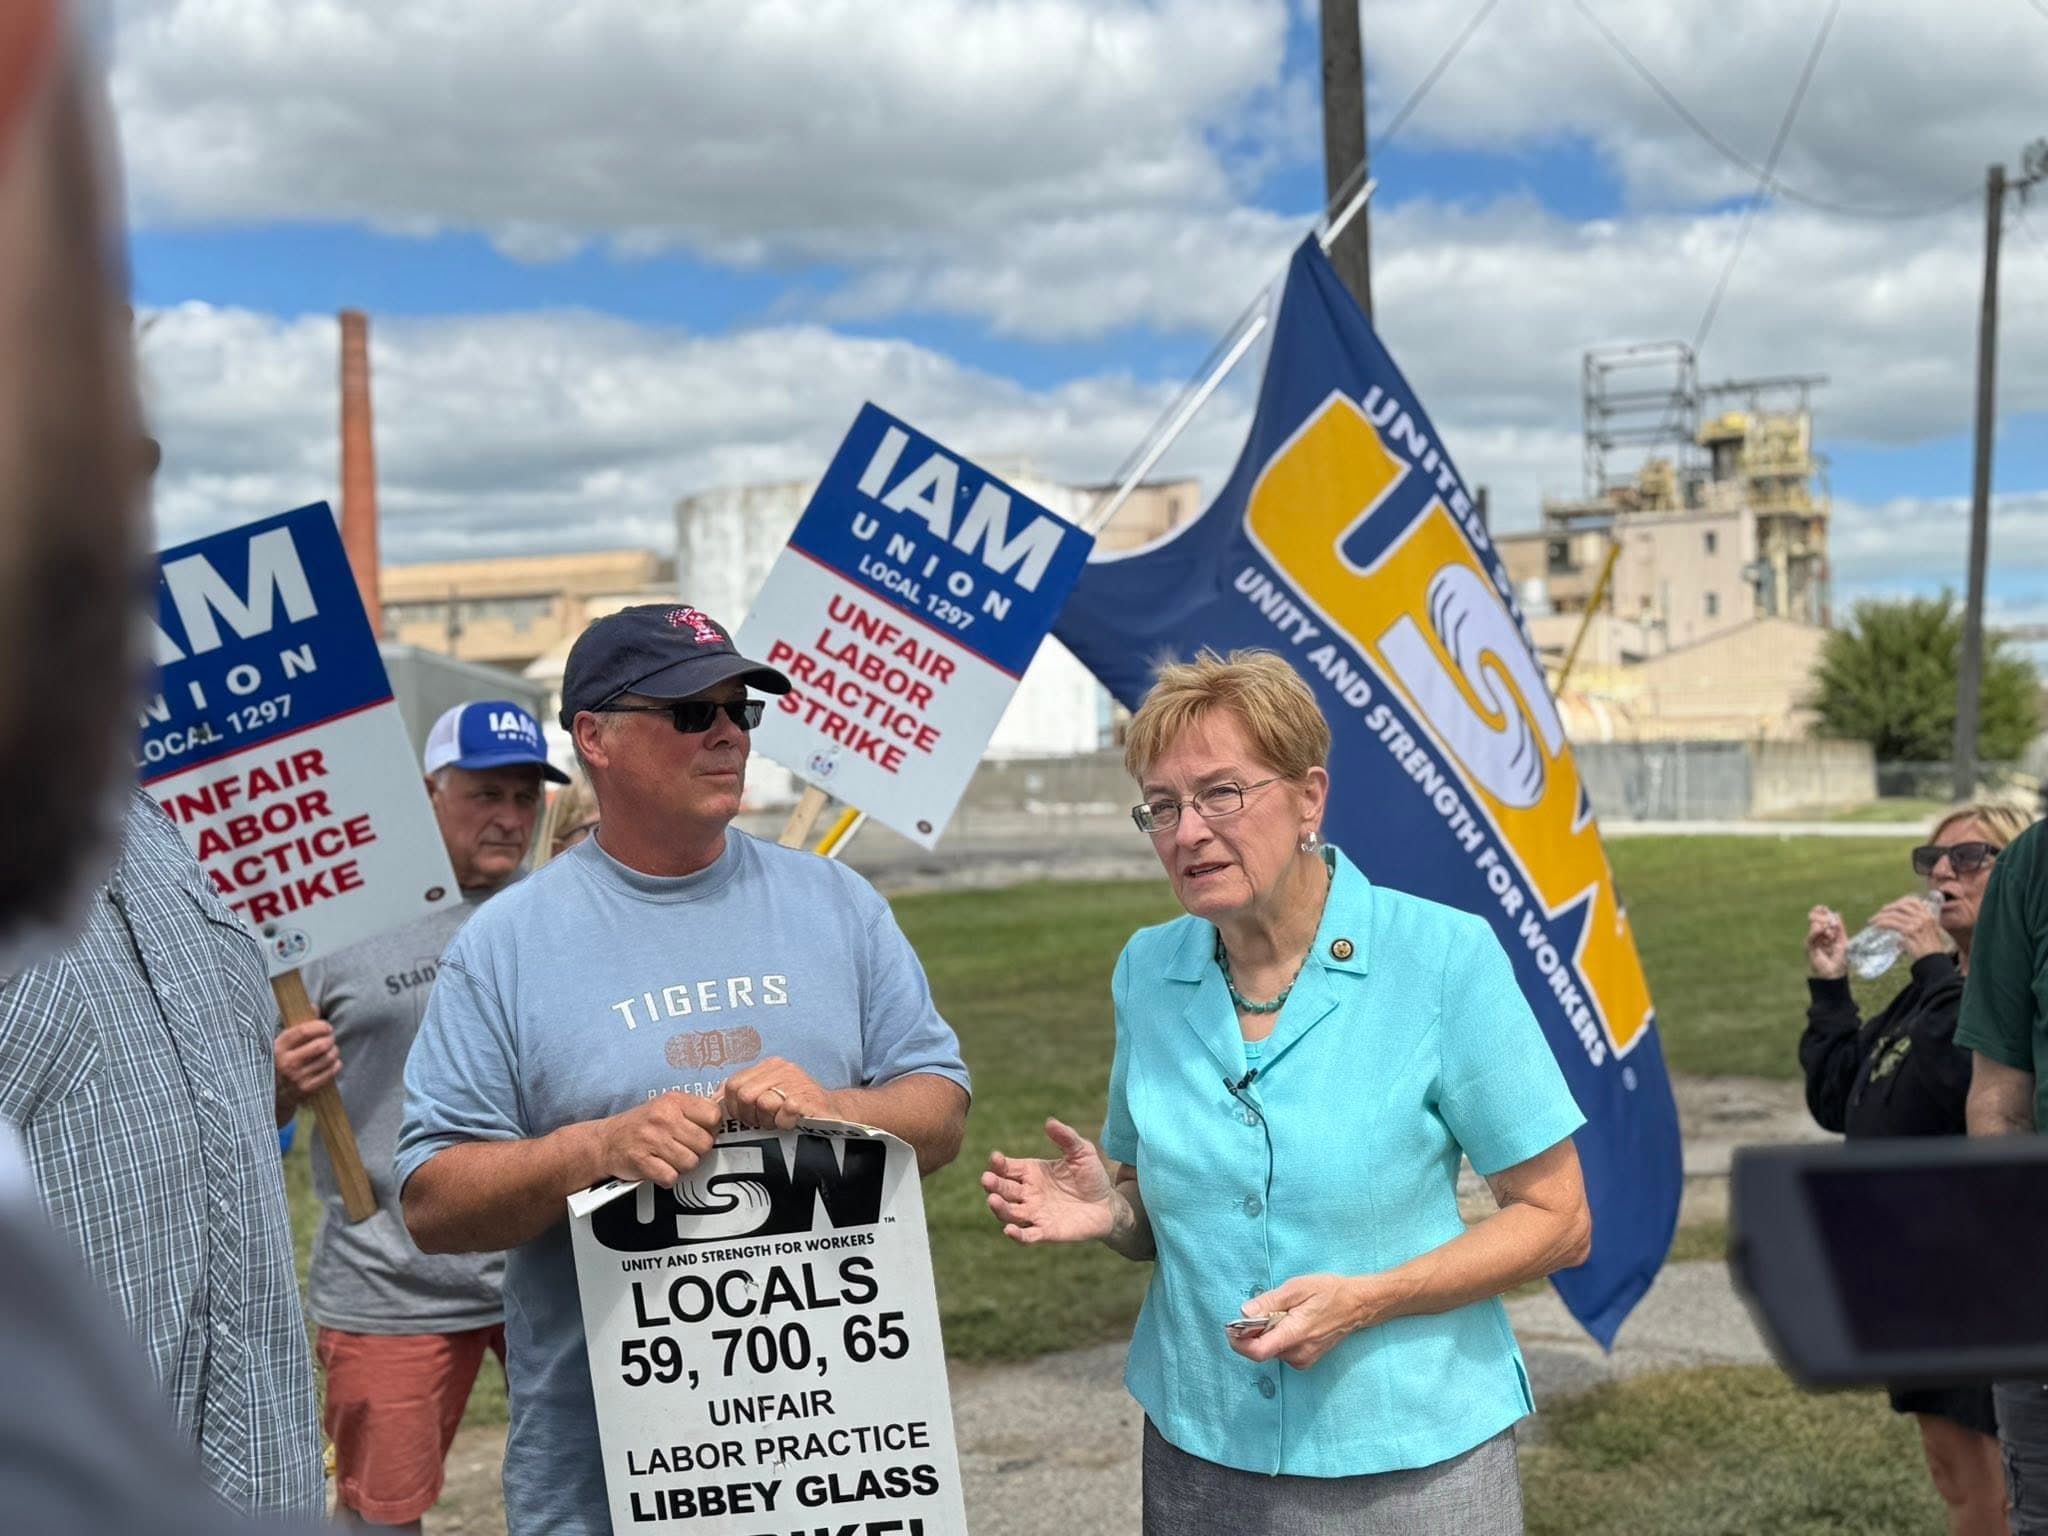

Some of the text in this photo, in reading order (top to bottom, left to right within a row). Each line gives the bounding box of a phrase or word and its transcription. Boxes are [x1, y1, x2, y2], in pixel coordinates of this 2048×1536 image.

[1360, 386, 1489, 550] UNITED
[857, 425, 1066, 593] IAM
[851, 512, 1012, 622] UNION
[858, 554, 975, 630] LOCAL 1297
[815, 628, 934, 710] LABOR
[828, 594, 956, 685] UNFAIR
[138, 644, 317, 728] NION
[226, 694, 293, 735] 1297
[767, 640, 942, 754] PRACTICE
[777, 687, 907, 775] STRIKE
[198, 789, 333, 862] ABOR
[208, 814, 378, 894] ACTICE
[1234, 566, 1608, 1067] UNITY AND STRENGTH FOR WORKERS
[230, 860, 365, 924] RIKE
[385, 958, 441, 996] Stan
[612, 975, 788, 1030] TIGERS
[622, 1232, 875, 1272] UNITY AND STRENGTH FOR WORKERS
[631, 1256, 879, 1329] LOCALS
[620, 1311, 909, 1390] 59, 700, 65
[708, 1389, 836, 1426] UNFAIR
[627, 1421, 930, 1476] LABOR PRACTICE
[630, 1464, 940, 1523] LIBBEY GLASS
